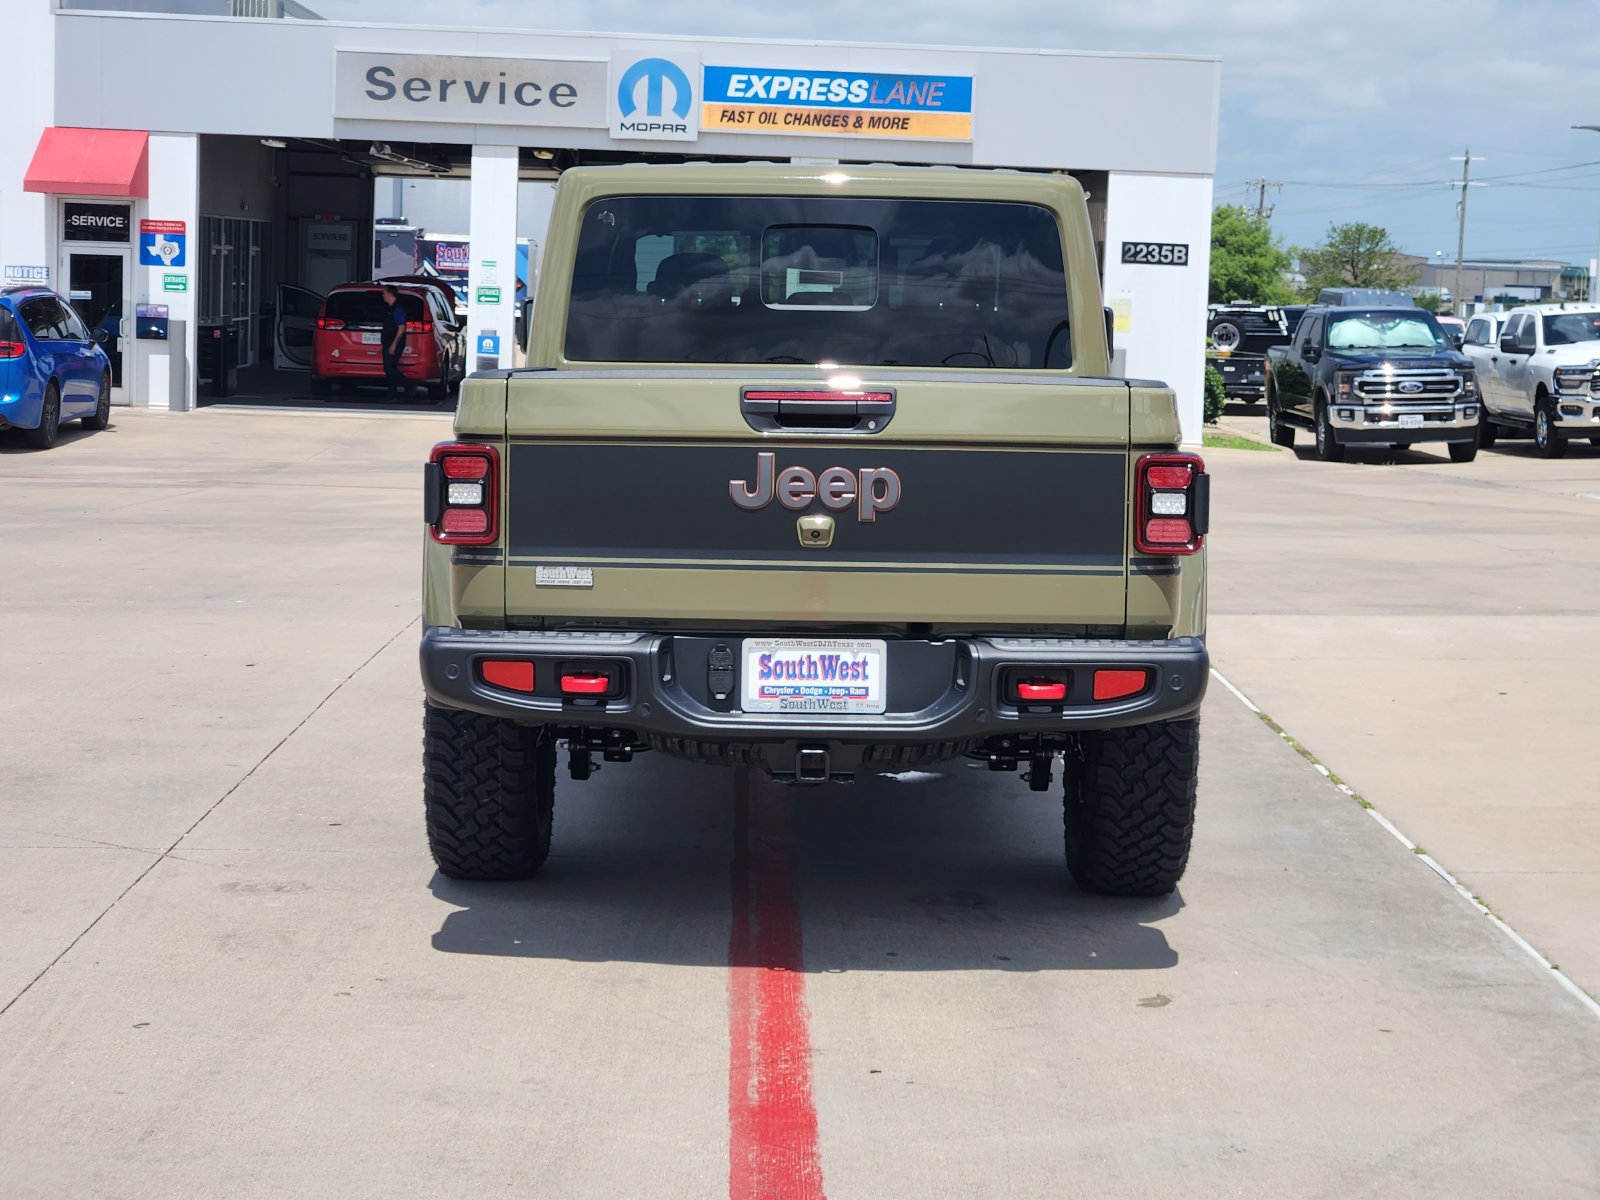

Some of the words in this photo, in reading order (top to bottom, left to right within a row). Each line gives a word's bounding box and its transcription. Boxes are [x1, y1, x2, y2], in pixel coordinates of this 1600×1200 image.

[365, 66, 578, 108] Service
[727, 74, 870, 103] EXPRESS
[869, 80, 946, 106] LANE
[720, 110, 756, 123] FAST
[758, 112, 779, 125] OIL
[783, 112, 849, 128] CHANGES
[853, 115, 864, 128] &
[868, 116, 910, 130] MORE
[620, 122, 687, 133] MOPAR
[71, 215, 124, 227] SERVICE
[1123, 244, 1187, 263] 2235B
[6, 267, 49, 278] NOTICE
[164, 275, 187, 283] ENTRANCE
[479, 288, 500, 296] ENTRANCE
[729, 452, 901, 522] Jeep
[536, 566, 593, 579] SouthWest
[758, 653, 869, 682] SouthWest
[764, 686, 794, 696] Chrysler
[800, 686, 823, 696] Dodge
[828, 687, 845, 696] Jeep
[850, 687, 866, 695] Ram
[780, 698, 848, 710] SouthWest
